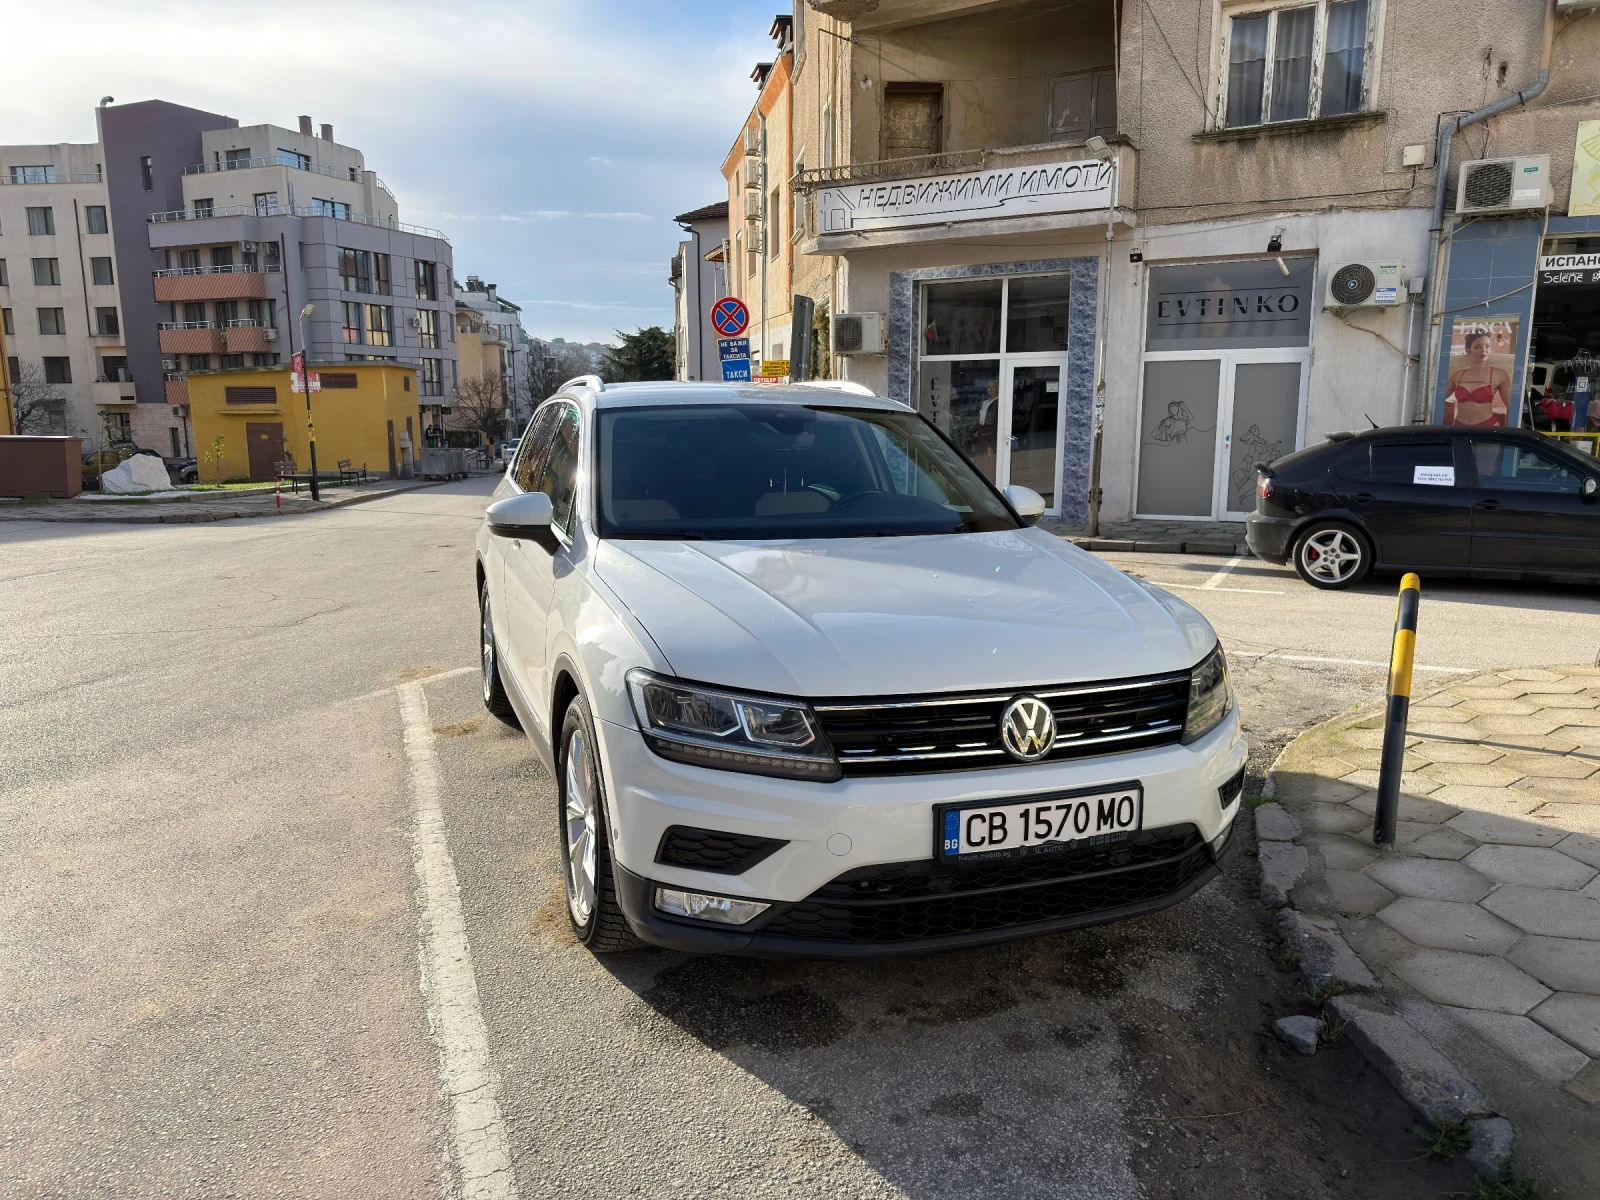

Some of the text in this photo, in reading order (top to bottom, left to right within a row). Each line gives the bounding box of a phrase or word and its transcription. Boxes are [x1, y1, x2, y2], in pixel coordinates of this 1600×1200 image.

[858, 162, 1112, 210] НЕДВИЖИМИ ИМОТИ
[1157, 294, 1300, 318] EVTINKO
[1460, 320, 1514, 335] LISCA
[725, 369, 749, 379] ТАКСИ
[966, 811, 1008, 847] CB
[1019, 801, 1090, 842] 1570
[1096, 795, 1134, 832] MO
[944, 838, 958, 850] BG
[1043, 844, 1064, 853] AUTO
